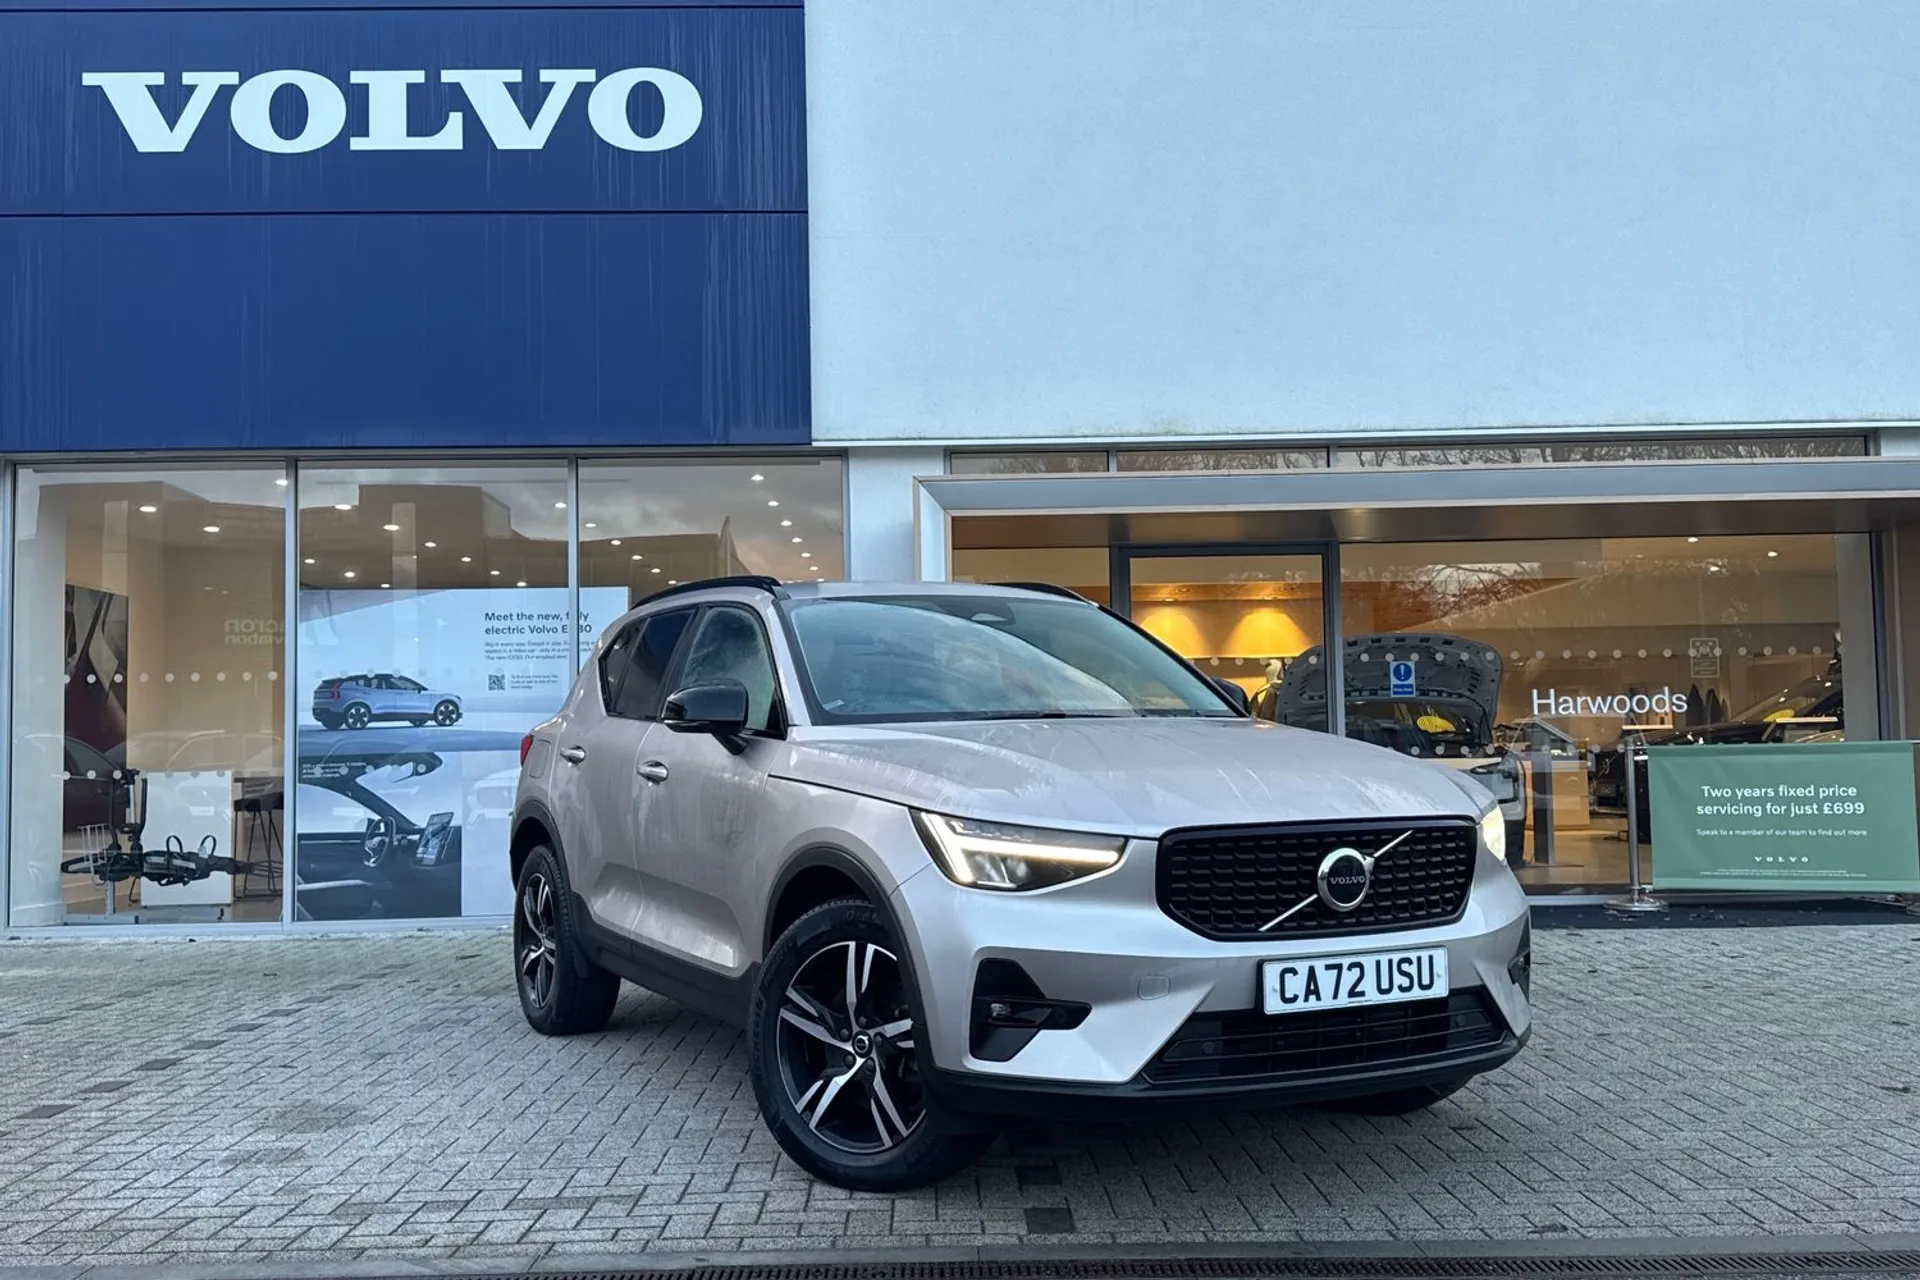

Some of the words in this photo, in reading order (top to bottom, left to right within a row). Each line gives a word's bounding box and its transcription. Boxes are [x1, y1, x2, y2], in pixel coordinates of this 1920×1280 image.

[82, 67, 703, 154] VOLVO
[484, 612, 514, 621] Meet
[516, 611, 535, 621] the
[537, 612, 563, 622] new,
[484, 624, 526, 635] electric
[528, 624, 559, 634] Volvo
[1532, 686, 1689, 716] Harwoods
[1701, 785, 1732, 797] Two
[1735, 786, 1775, 800] years
[1778, 784, 1815, 797] fixed
[1819, 784, 1858, 799] price
[1696, 802, 1763, 817] servicing
[1766, 802, 1787, 815] for
[1790, 802, 1819, 817] just
[1822, 801, 1865, 815] £699
[1696, 828, 1718, 836] Speak
[1817, 828, 1832, 836] find
[1754, 855, 1809, 863] VOLVO
[1329, 875, 1365, 885] VOLVO
[1279, 961, 1366, 1005] CA72
[1375, 954, 1434, 996] USU
